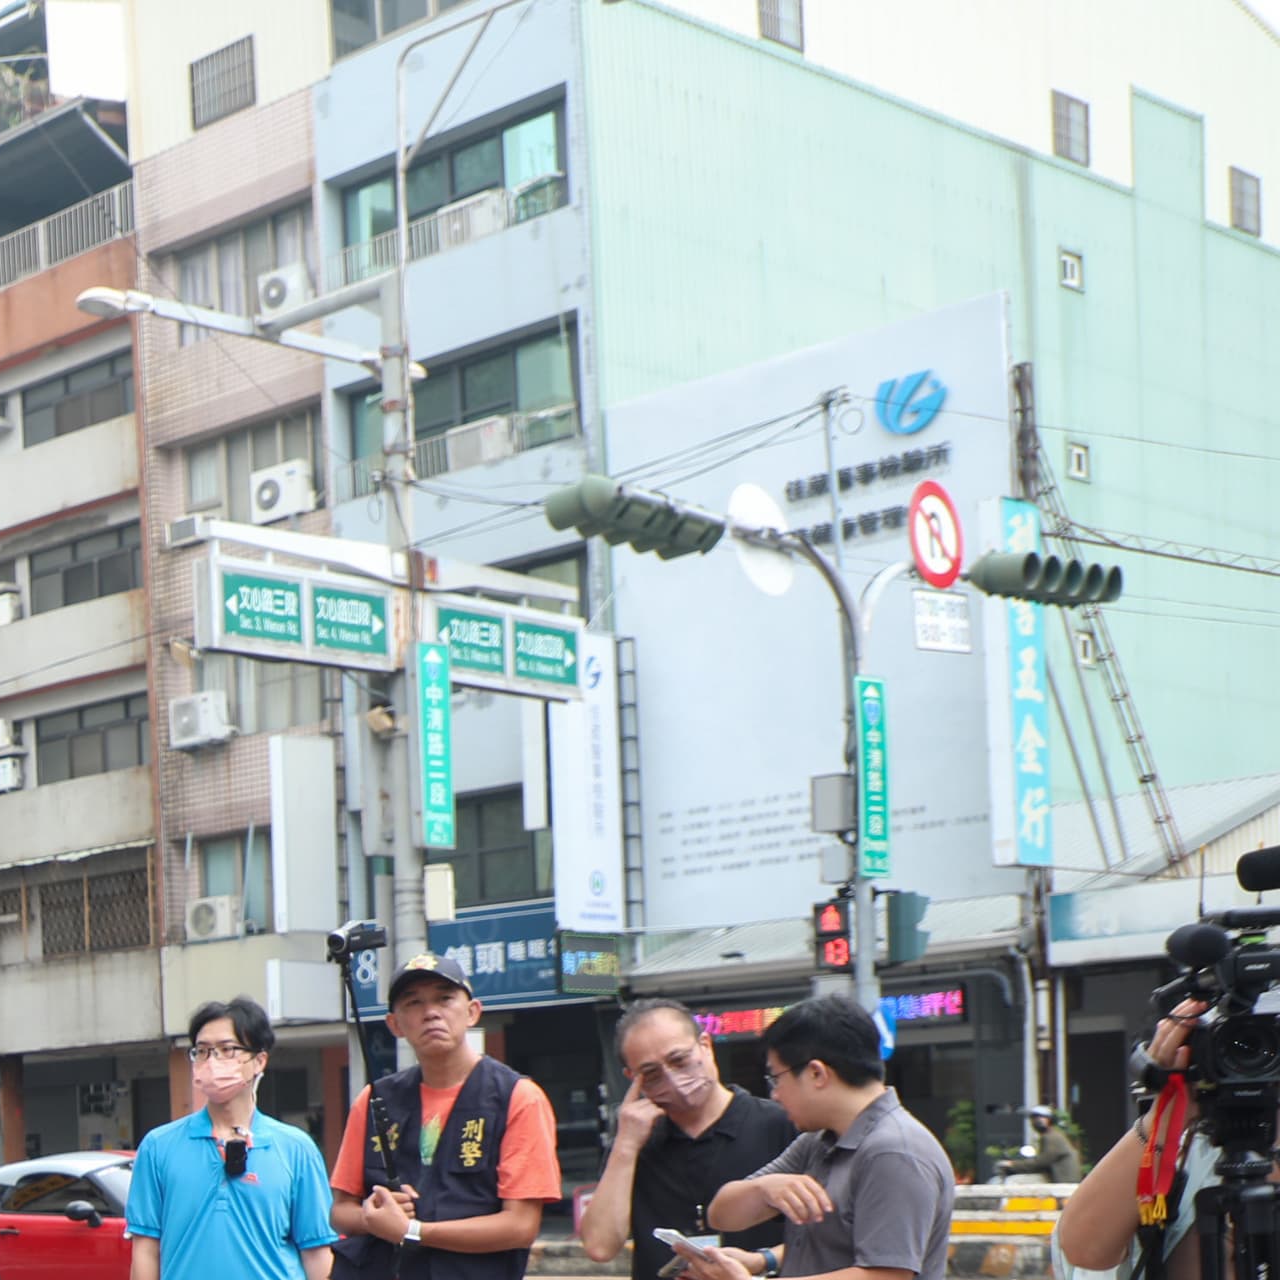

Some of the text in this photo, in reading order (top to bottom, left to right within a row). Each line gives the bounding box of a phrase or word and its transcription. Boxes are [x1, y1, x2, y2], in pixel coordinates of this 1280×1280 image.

[238, 585, 299, 618] 文心路三段
[458, 1117, 486, 1168] 刑警
